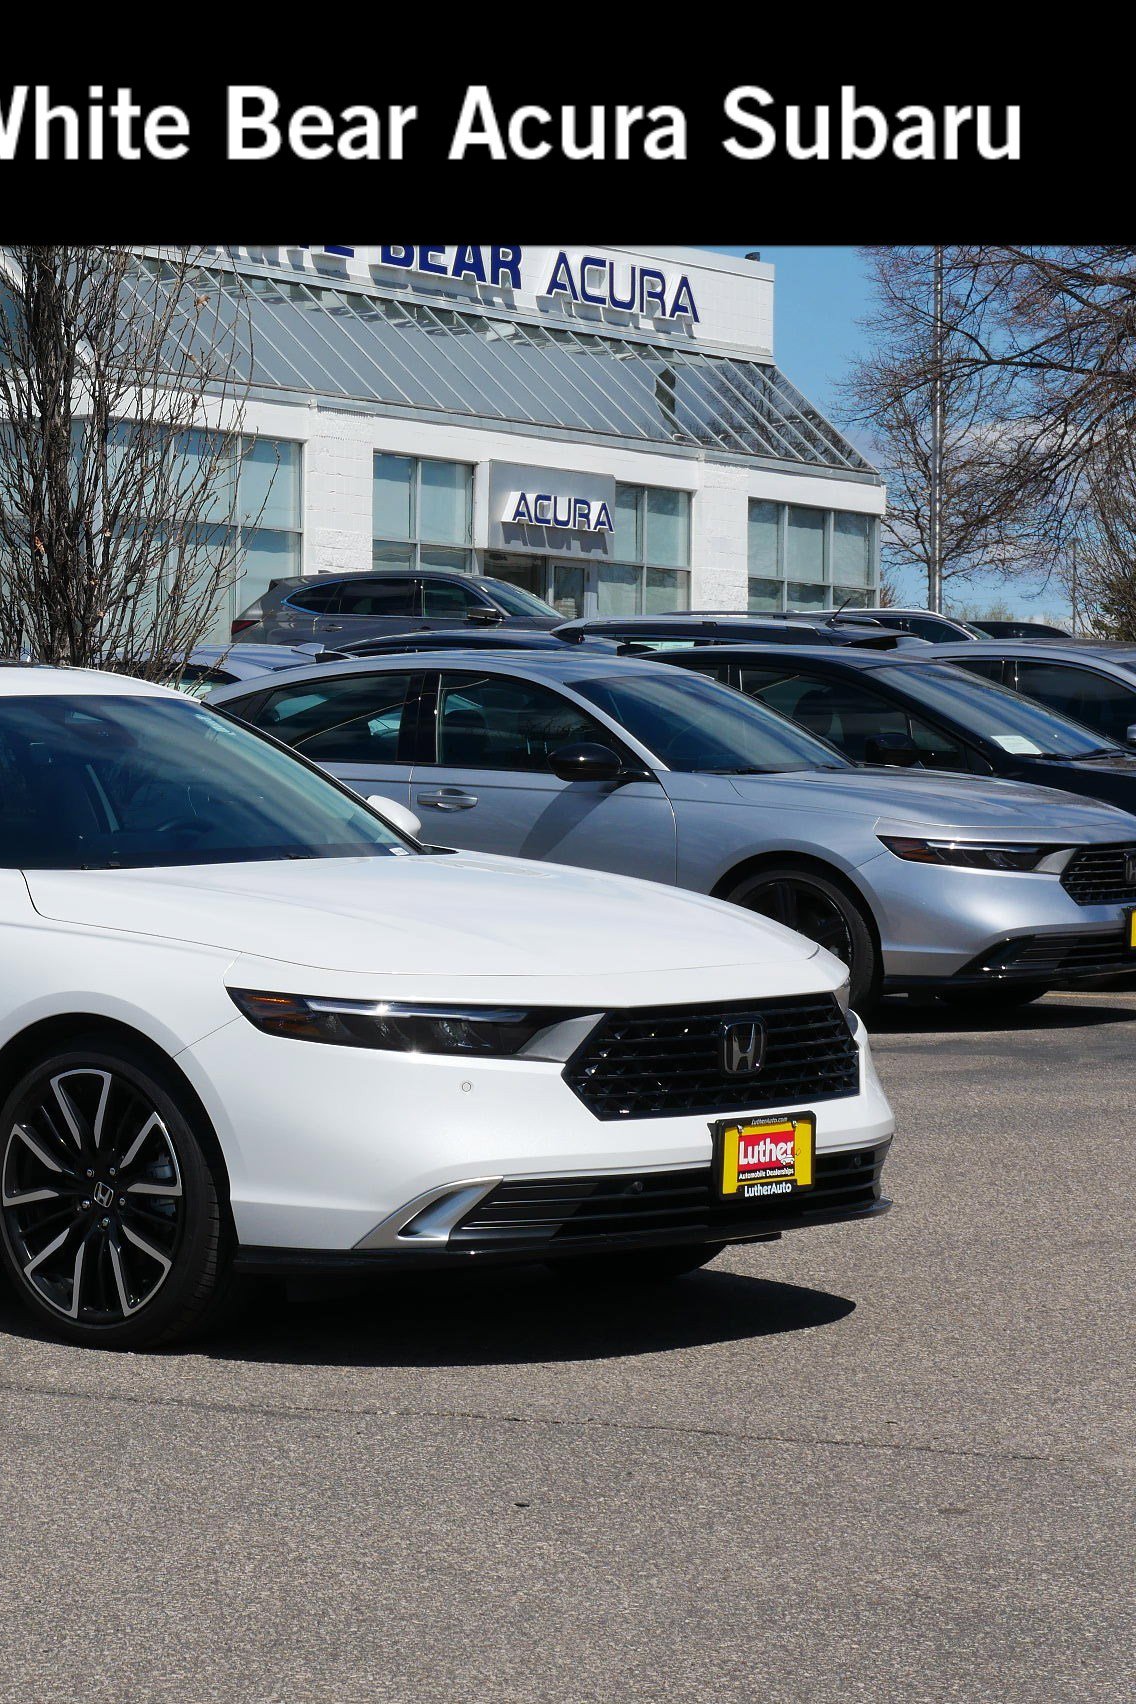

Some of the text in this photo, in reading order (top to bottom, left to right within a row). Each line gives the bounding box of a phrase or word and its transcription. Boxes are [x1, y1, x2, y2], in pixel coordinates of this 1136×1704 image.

[545, 250, 701, 324] ACURA
[510, 491, 614, 533] ACURA
[739, 1138, 794, 1165] Luther
[738, 1168, 794, 1179] Automobile Dealerships
[744, 1182, 791, 1197] LutherAuto
